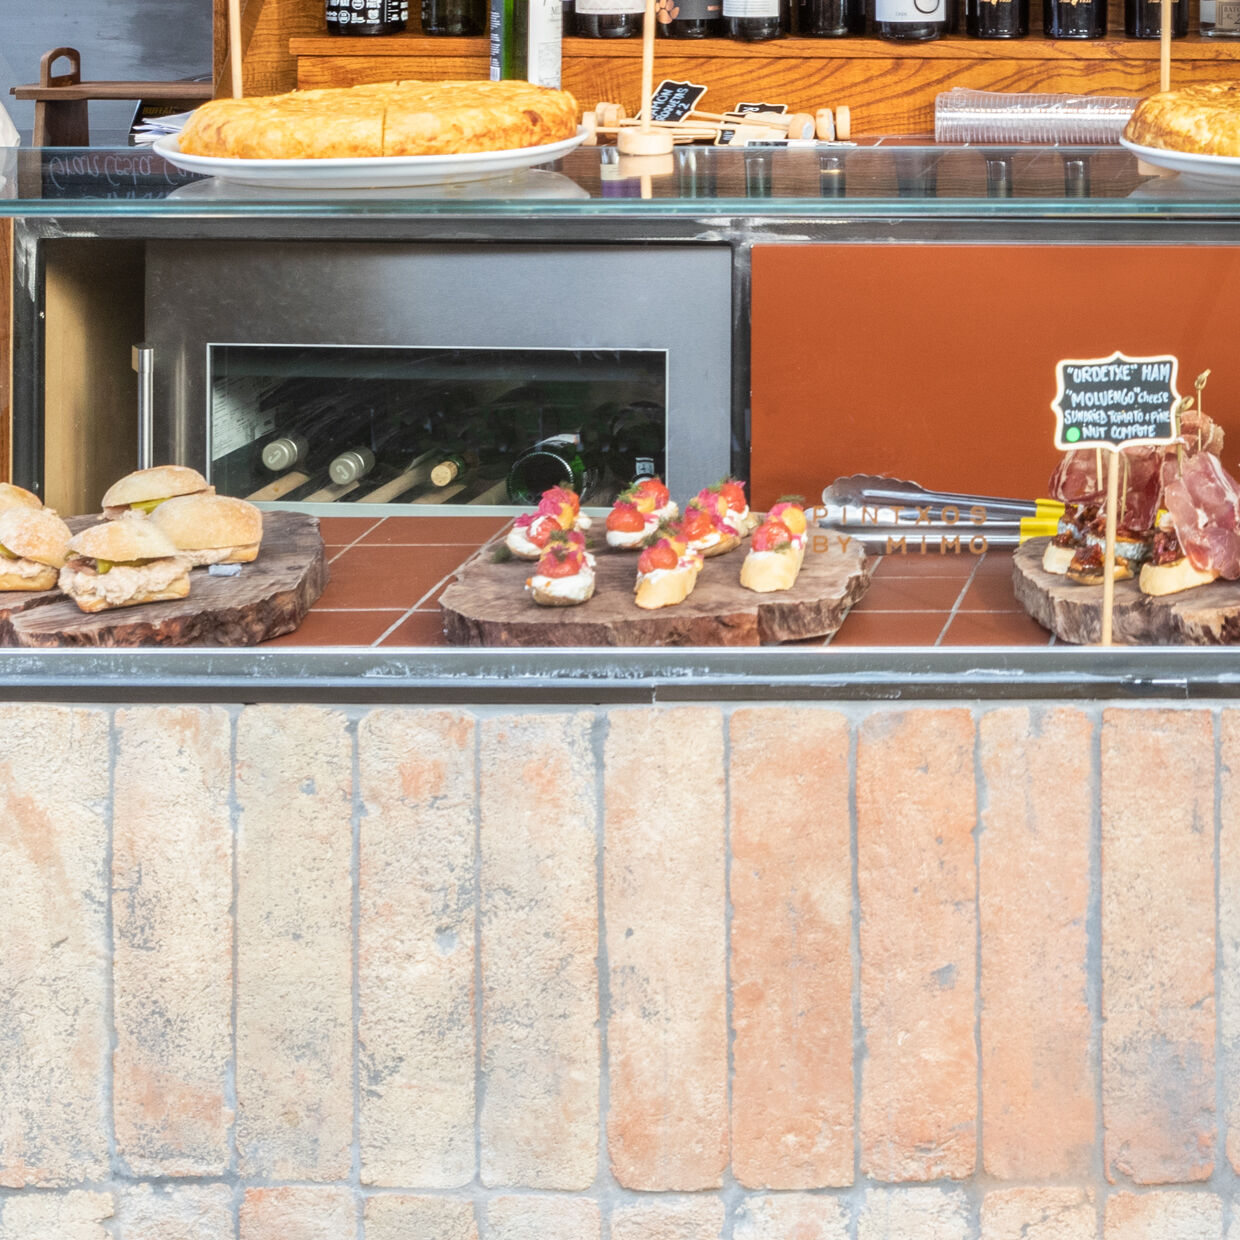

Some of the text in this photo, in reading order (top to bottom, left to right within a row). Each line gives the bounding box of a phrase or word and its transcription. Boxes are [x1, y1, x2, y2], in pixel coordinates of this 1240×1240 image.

[1141, 363, 1170, 383] HAM
[1082, 424, 1108, 439] NUT
[812, 505, 988, 525] PINTXOS
[812, 534, 989, 555] BY MIMO
